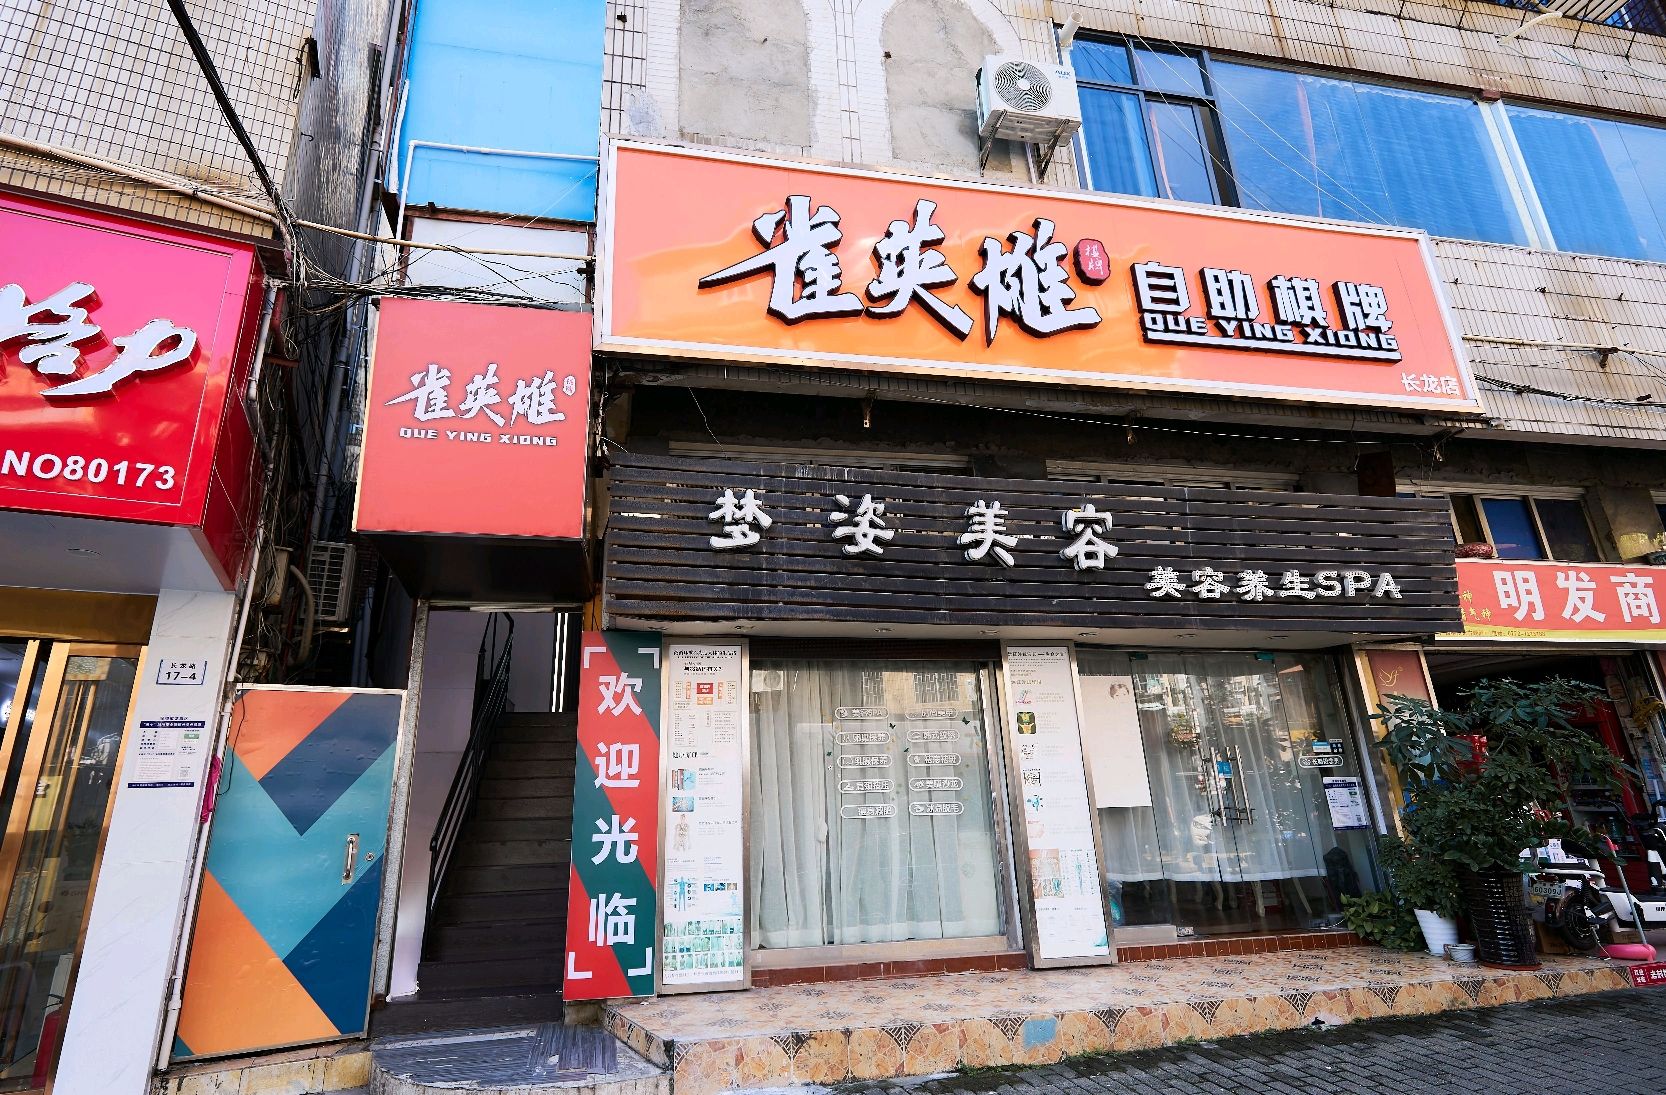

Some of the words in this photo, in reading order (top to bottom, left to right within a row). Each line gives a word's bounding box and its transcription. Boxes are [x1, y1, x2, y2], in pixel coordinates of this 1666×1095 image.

[698, 195, 1101, 347] 雀英雄
[1131, 261, 1393, 334] 自助棋牌
[1140, 312, 1208, 335] QUE
[1215, 319, 1295, 342] YING
[1301, 327, 1399, 350] XIONG
[384, 363, 566, 428] 雀英雄
[1400, 372, 1460, 396] 长龙店
[399, 427, 438, 439] QUE
[446, 430, 492, 443] YING
[499, 434, 558, 446] XIONG
[1, 449, 176, 490] NO80173
[708, 488, 1118, 572] 梦姿美容
[1144, 565, 1402, 601] 美容养生SPA
[1492, 570, 1661, 625] 明发商
[166, 671, 197, 681] 17-4
[588, 672, 644, 947] 欢迎光临
